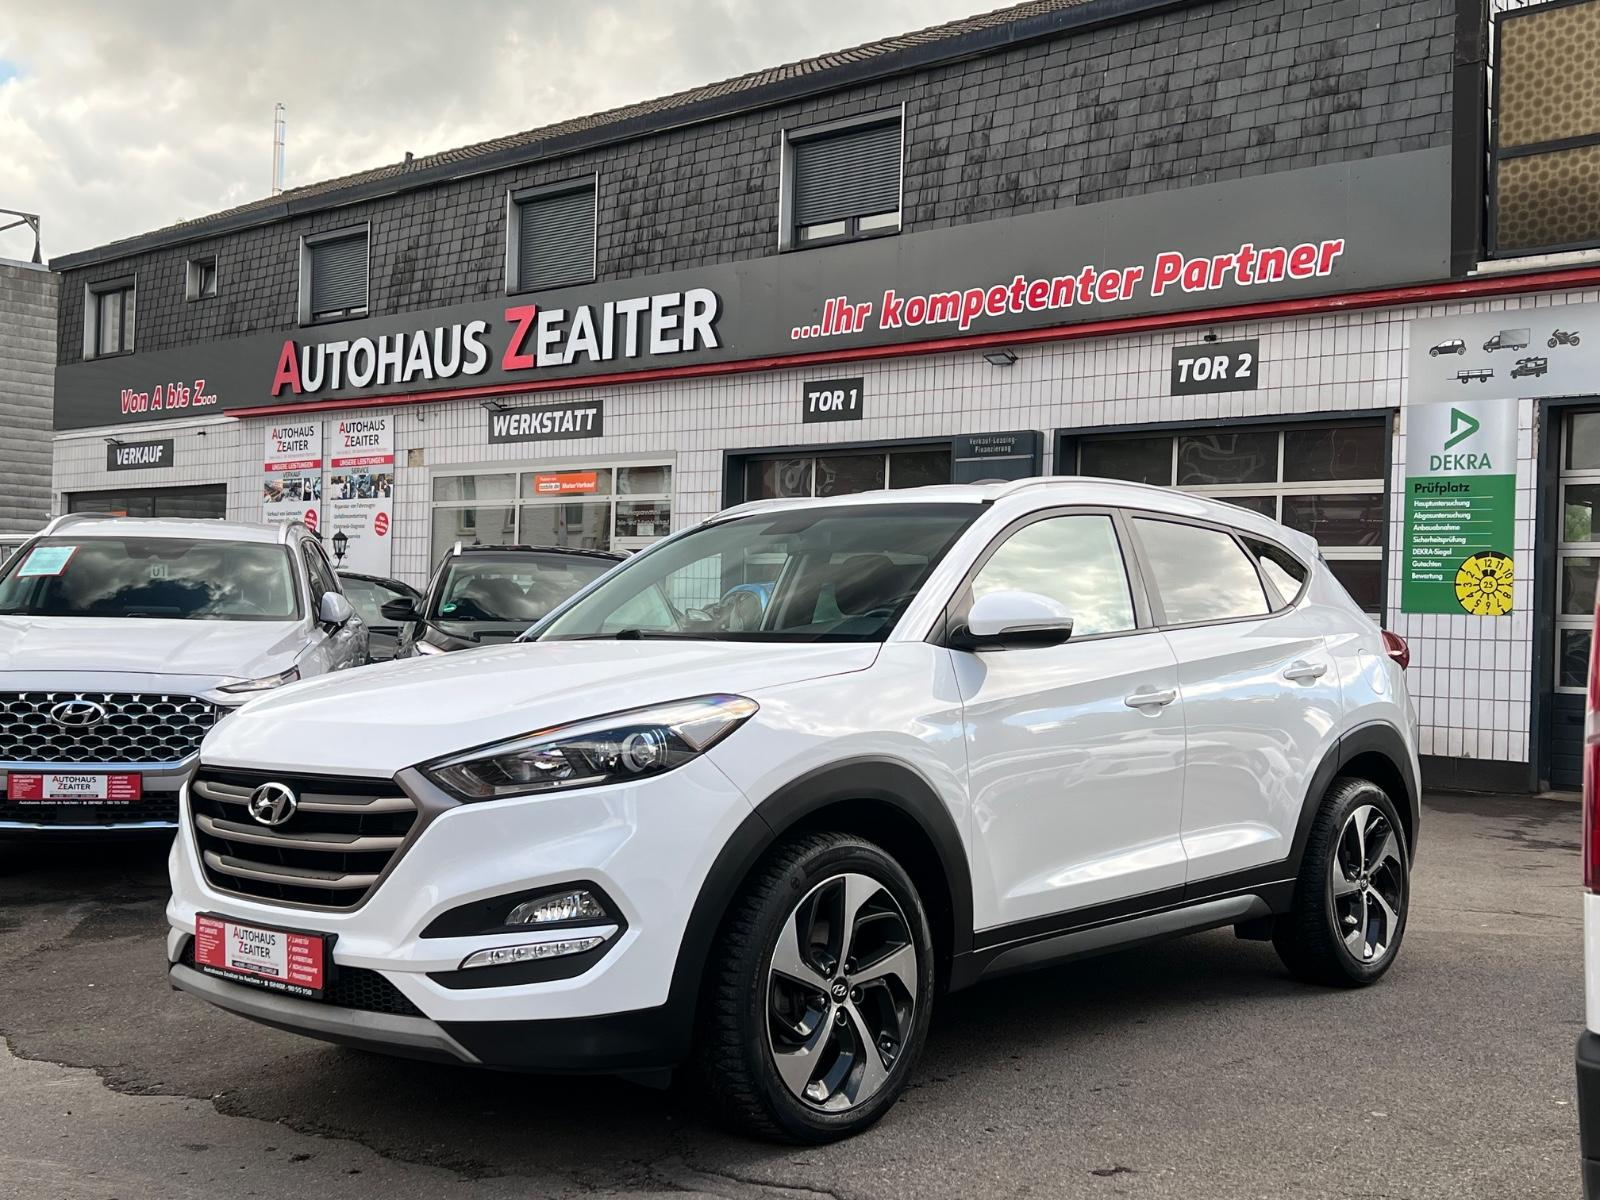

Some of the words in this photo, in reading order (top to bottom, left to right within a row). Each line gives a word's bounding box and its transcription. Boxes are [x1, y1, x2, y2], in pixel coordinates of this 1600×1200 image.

[791, 296, 872, 340] ...Ihr
[879, 264, 1145, 331] kompetenter
[1150, 238, 1346, 297] Partner
[271, 320, 487, 397] AUTOHAUS
[501, 287, 720, 372] ZEAITER
[1177, 355, 1229, 383] TOR
[1234, 353, 1252, 378] 2
[121, 389, 149, 414] Von
[150, 385, 163, 411] A
[166, 382, 190, 409] bis
[808, 390, 845, 413] TOR
[849, 388, 858, 410] 1
[339, 419, 386, 435] AUTOHAUS
[493, 408, 598, 437] WERKSTATT
[272, 425, 314, 440] AUTOHAUS
[276, 440, 309, 453] ZEAITER
[344, 434, 380, 448] ZEAITER
[974, 445, 1012, 453] Finanzierung
[116, 445, 164, 465] VERKAUF
[358, 456, 385, 465] LEISTUNGEN
[288, 461, 314, 469] LEISTUNGEN
[1429, 453, 1492, 472] DEKRA
[351, 466, 370, 474] SERVICE
[1414, 482, 1470, 495] Prüfplatz
[1413, 512, 1471, 520] Abgasuntersuchung
[1412, 536, 1467, 544] Sicherheitsprüfung
[1412, 548, 1452, 556] DEKRA-Siegel
[1475, 563, 1480, 571] 1
[1484, 559, 1492, 568] 12
[1496, 560, 1504, 571] 11
[1411, 572, 1443, 580] Bewertung
[1465, 570, 1475, 578] 2
[1502, 568, 1513, 579] 10
[1502, 591, 1512, 599] 8
[1474, 599, 1481, 608] 5
[1497, 599, 1502, 608] 7
[52, 775, 97, 783] AUTOHAUS
[233, 926, 276, 946] AUTOHAUS
[238, 941, 271, 959] ZEAITER
